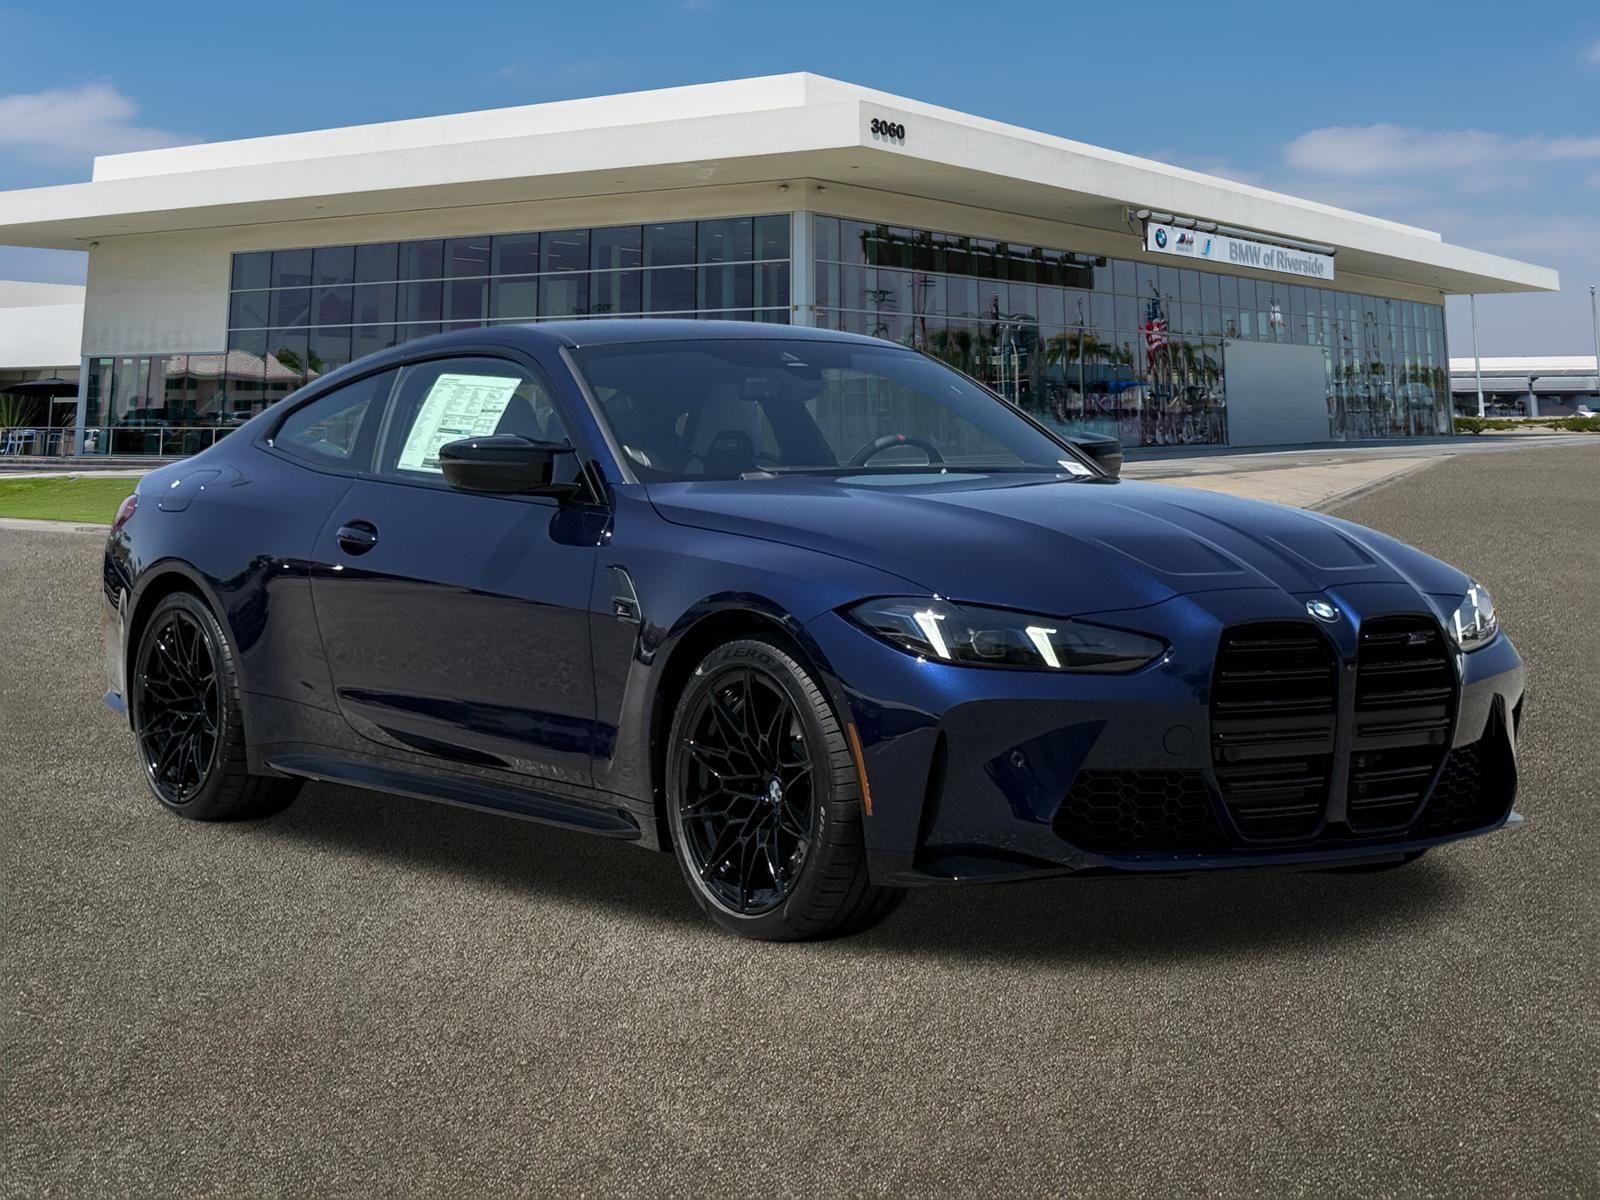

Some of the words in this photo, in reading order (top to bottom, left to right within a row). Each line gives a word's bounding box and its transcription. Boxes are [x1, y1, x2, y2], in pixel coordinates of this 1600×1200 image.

[871, 118, 905, 139] 3060
[1229, 241, 1261, 265] BMW
[1263, 249, 1275, 267] of
[1276, 250, 1324, 275] Riverside
